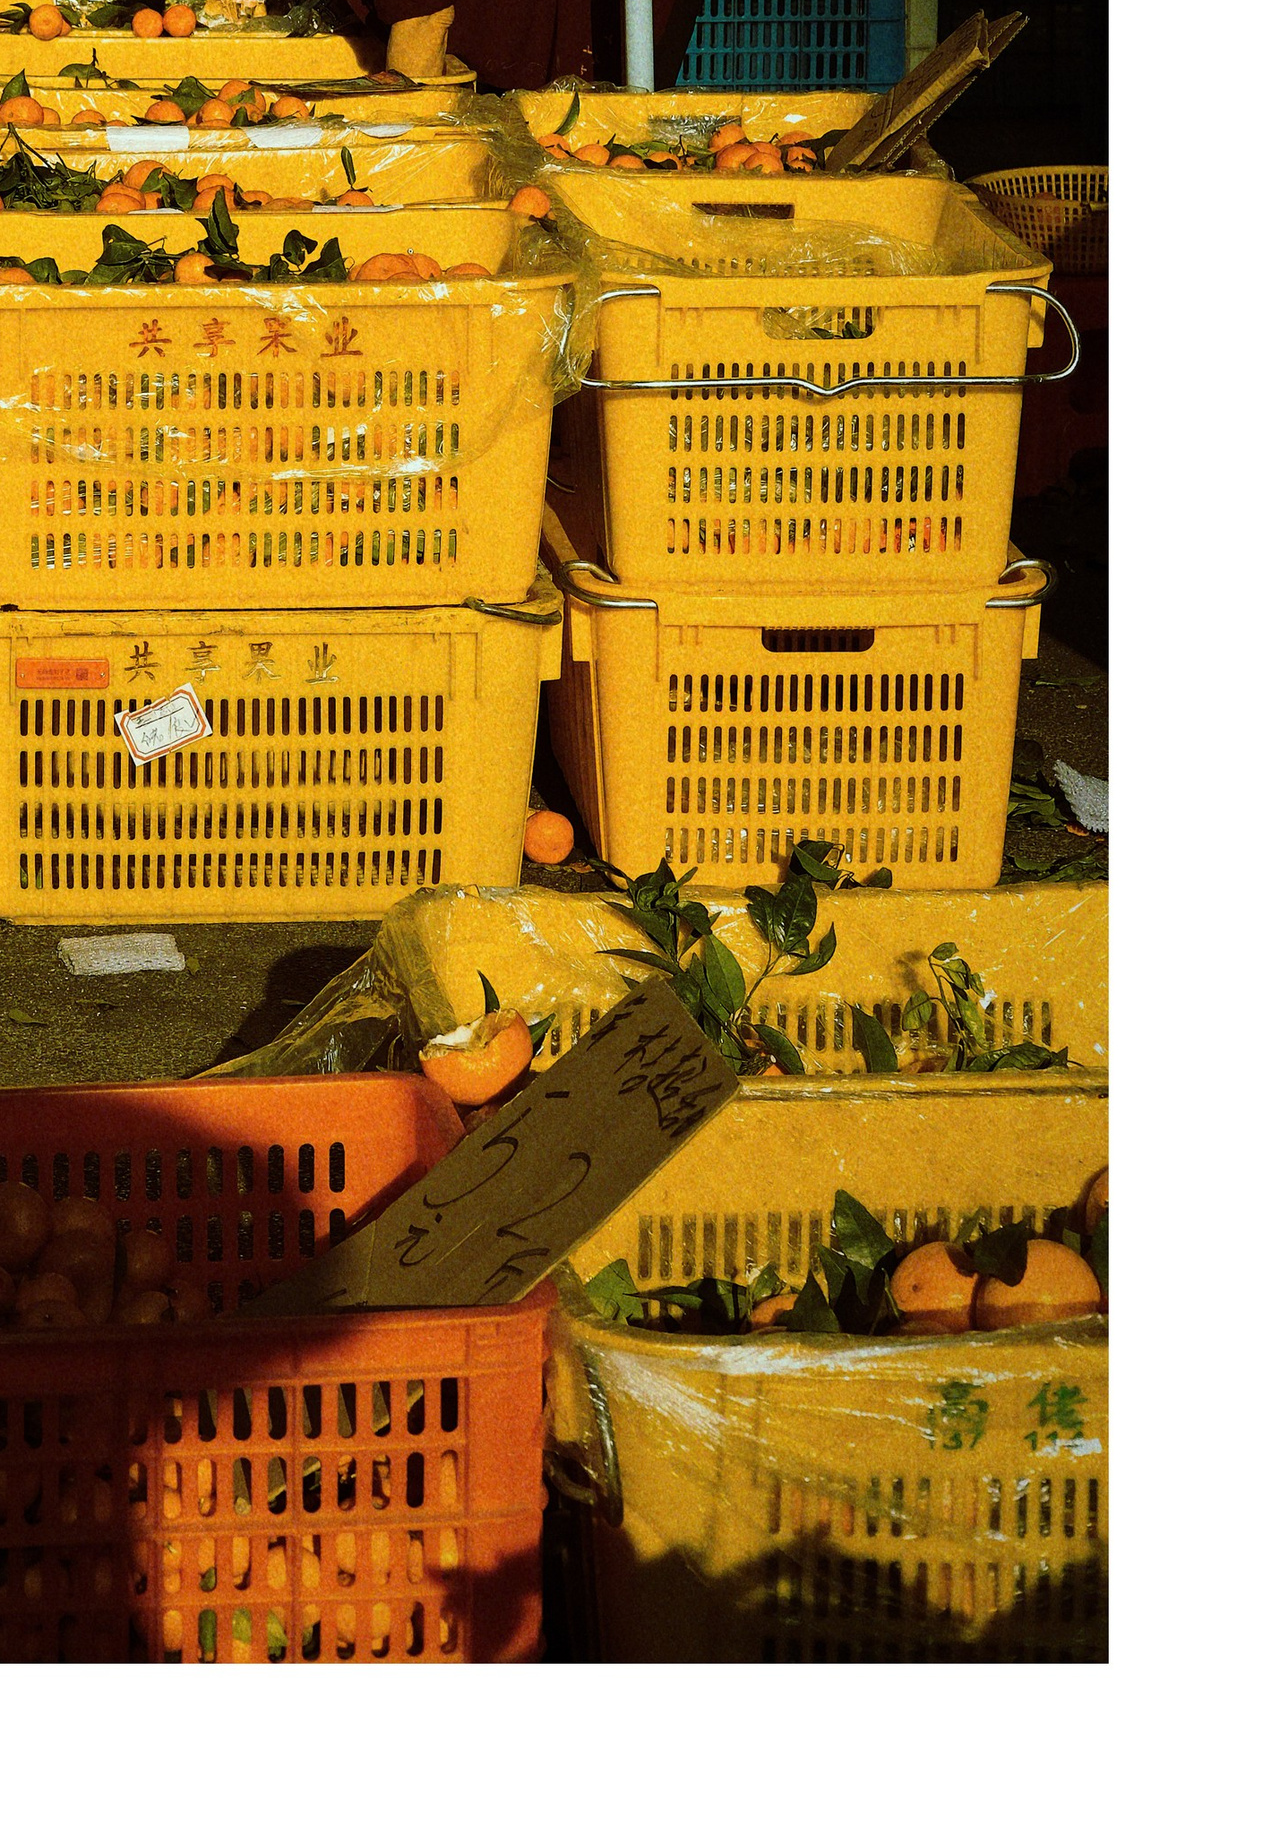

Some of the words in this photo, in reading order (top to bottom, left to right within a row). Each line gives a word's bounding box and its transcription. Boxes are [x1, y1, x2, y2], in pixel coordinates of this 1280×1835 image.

[128, 316, 363, 359] 共享果业
[123, 641, 339, 685] 共享果业
